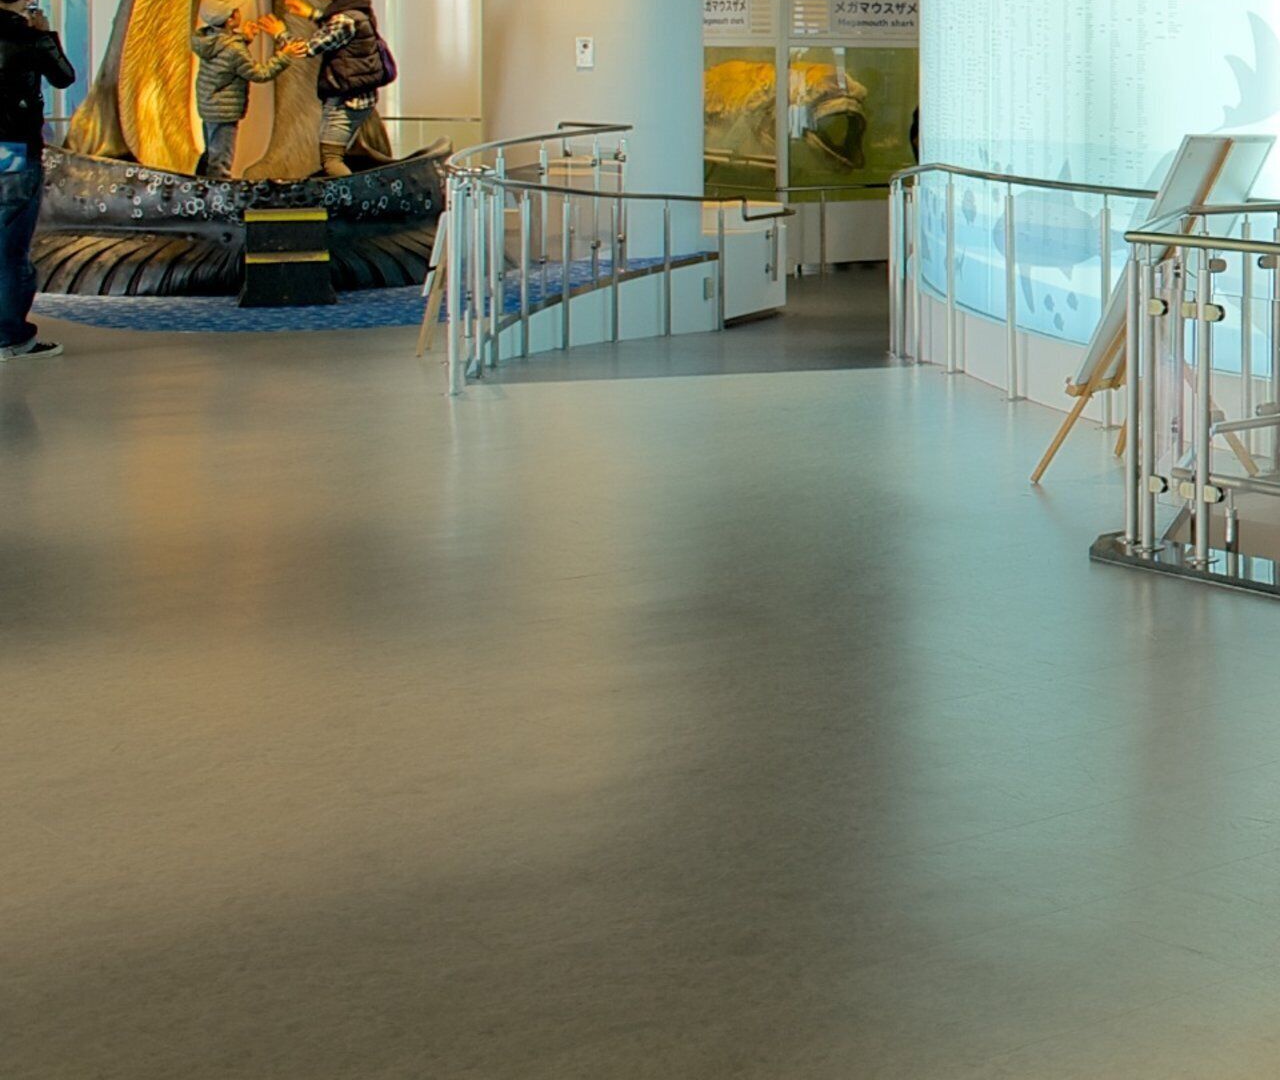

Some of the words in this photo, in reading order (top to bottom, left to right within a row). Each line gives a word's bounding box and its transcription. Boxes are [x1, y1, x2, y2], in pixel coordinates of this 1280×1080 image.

[703, 0, 747, 12] ガマウスザメ
[834, 1, 918, 15] メガマウスザメ
[890, 18, 915, 27] shark
